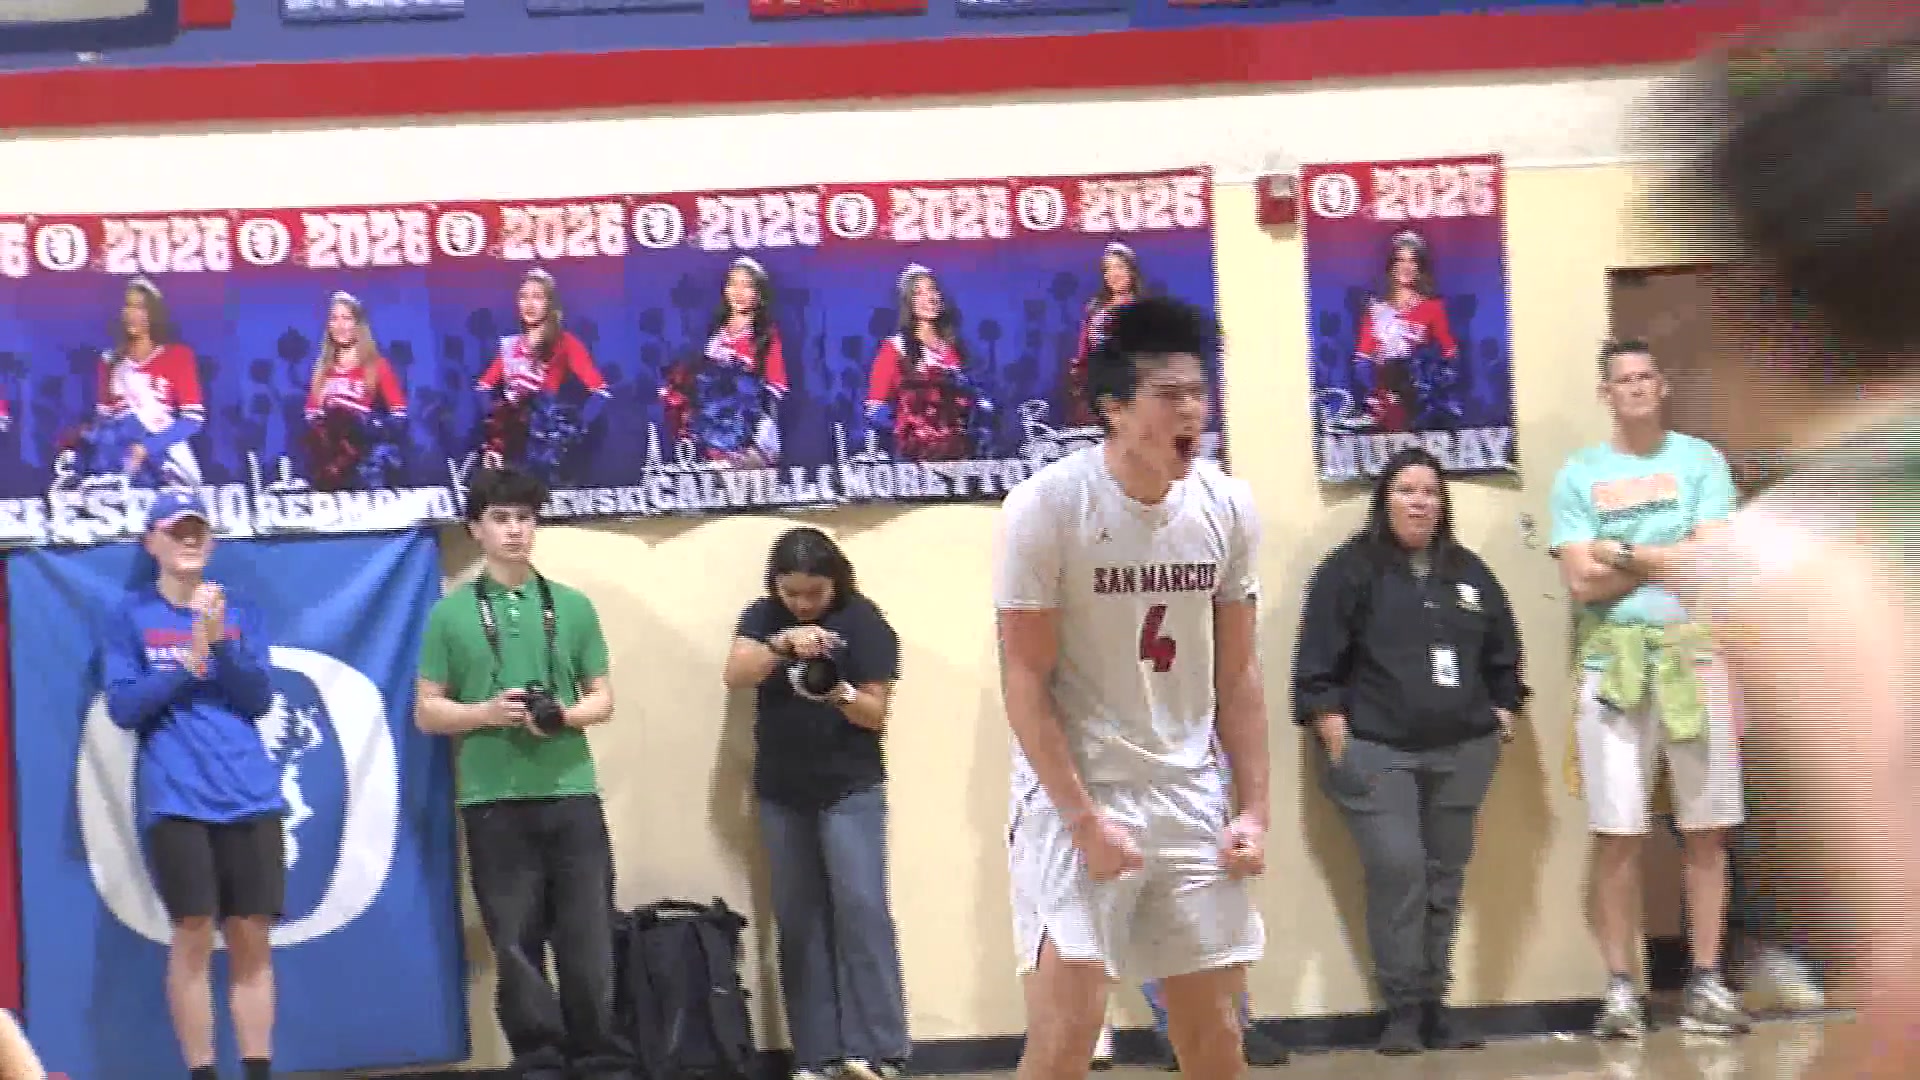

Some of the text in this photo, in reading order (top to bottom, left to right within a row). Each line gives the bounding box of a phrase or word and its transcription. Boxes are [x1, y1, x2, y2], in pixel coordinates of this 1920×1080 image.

[888, 185, 1011, 241] 2026
[1078, 176, 1208, 231] 2026
[1371, 164, 1498, 219] 2026
[101, 215, 232, 273] 2026
[302, 209, 431, 268] 2026
[501, 202, 628, 259] 2026
[696, 193, 822, 250] 2026
[1093, 566, 1136, 594] SAN
[1140, 604, 1177, 672] 4
